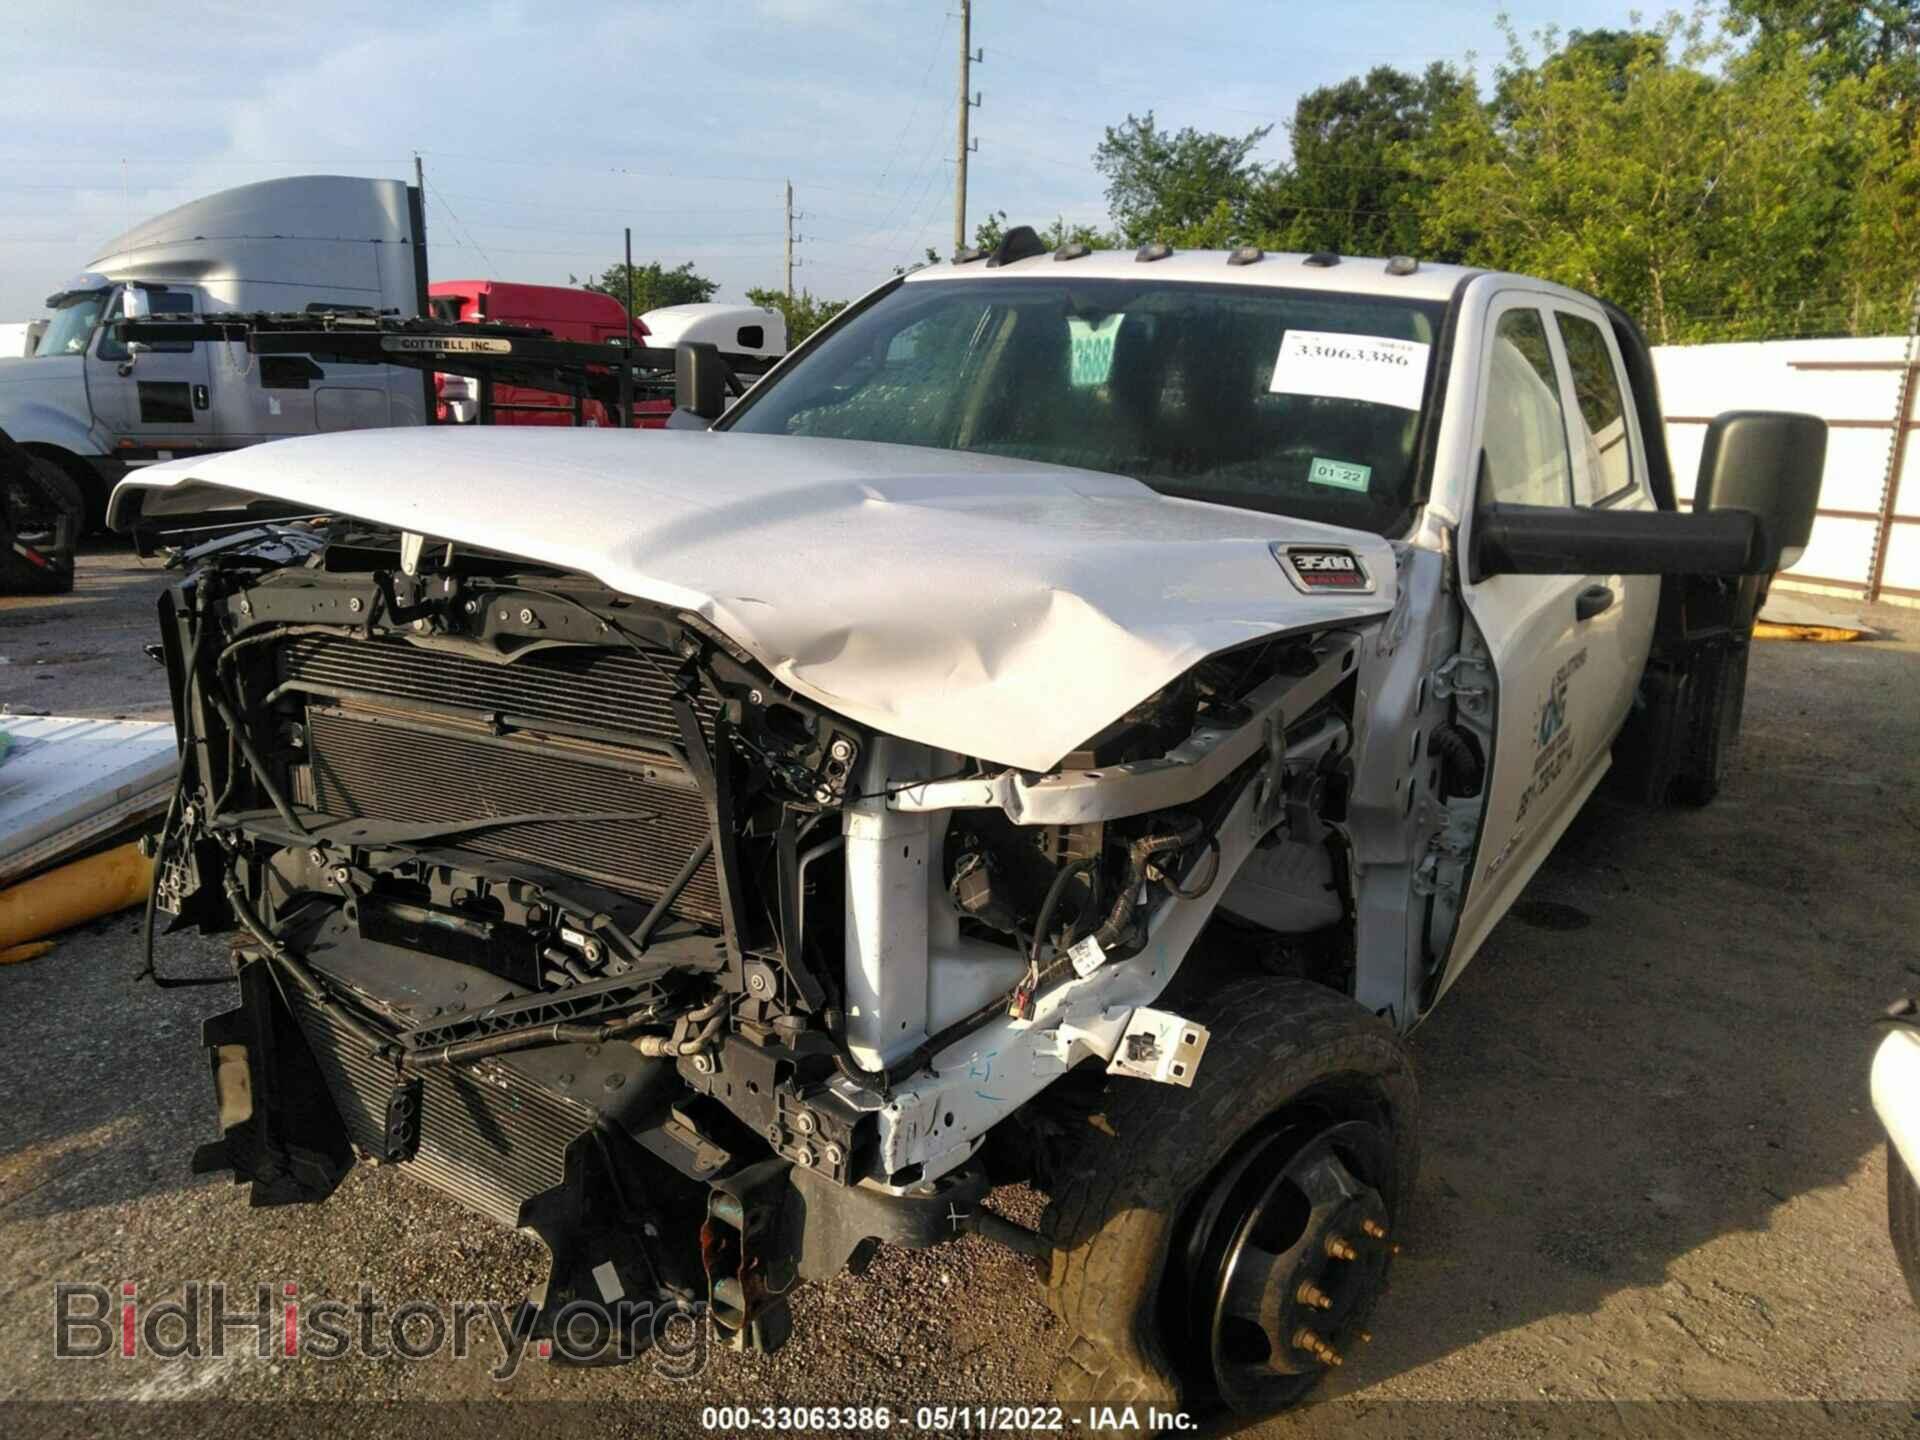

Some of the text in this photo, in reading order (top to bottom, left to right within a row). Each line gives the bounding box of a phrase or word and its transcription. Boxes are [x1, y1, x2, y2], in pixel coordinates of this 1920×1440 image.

[471, 340, 495, 352] INC.
[1294, 344, 1409, 367] 33063386
[1318, 465, 1361, 481] 01 22
[1295, 555, 1355, 571] 3500
